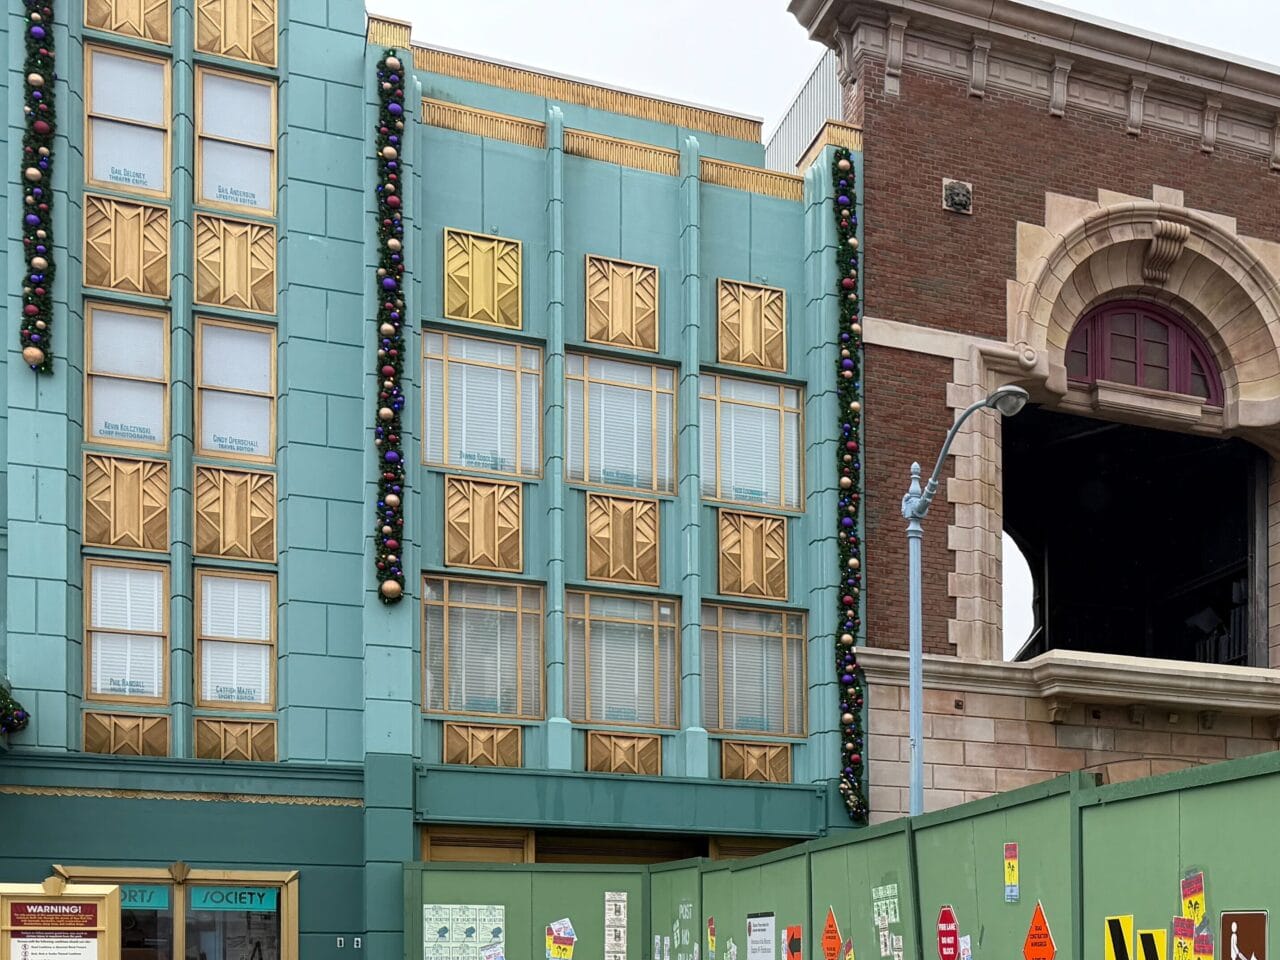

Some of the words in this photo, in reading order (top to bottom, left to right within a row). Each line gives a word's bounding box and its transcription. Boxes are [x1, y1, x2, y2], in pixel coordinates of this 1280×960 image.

[202, 890, 266, 904] SOCIETY
[26, 905, 82, 913] WARNING!
[679, 903, 693, 920] POST
[681, 929, 690, 945] NO
